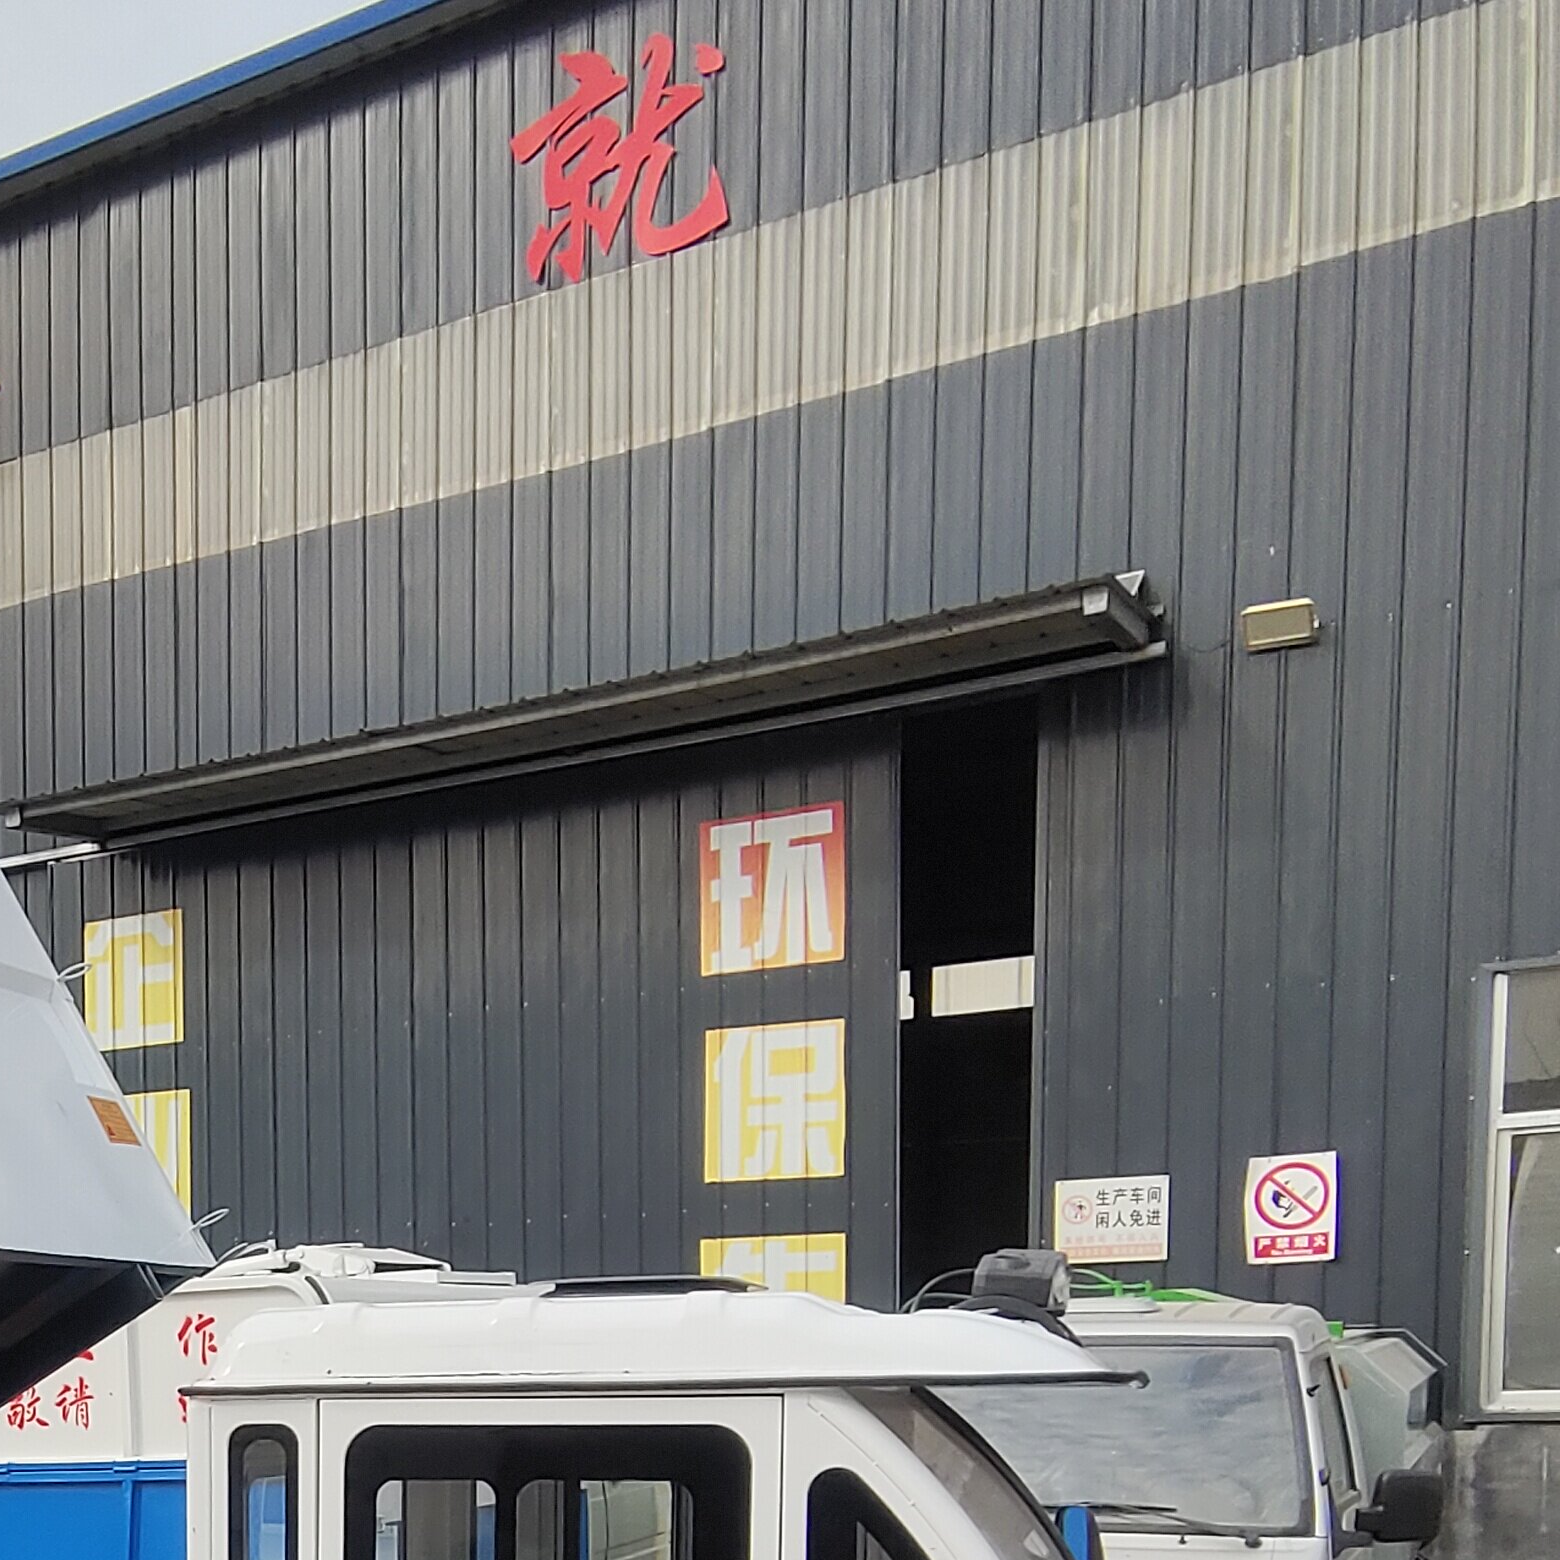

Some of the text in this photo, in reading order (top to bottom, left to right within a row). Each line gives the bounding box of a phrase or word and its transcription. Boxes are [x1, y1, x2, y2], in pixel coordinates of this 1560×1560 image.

[510, 32, 730, 284] 就
[1095, 1186, 1162, 1206] 生产车间
[1095, 1209, 1162, 1229] 闲人免进
[177, 1314, 218, 1366] 作
[7, 1376, 94, 1431] 敬请
